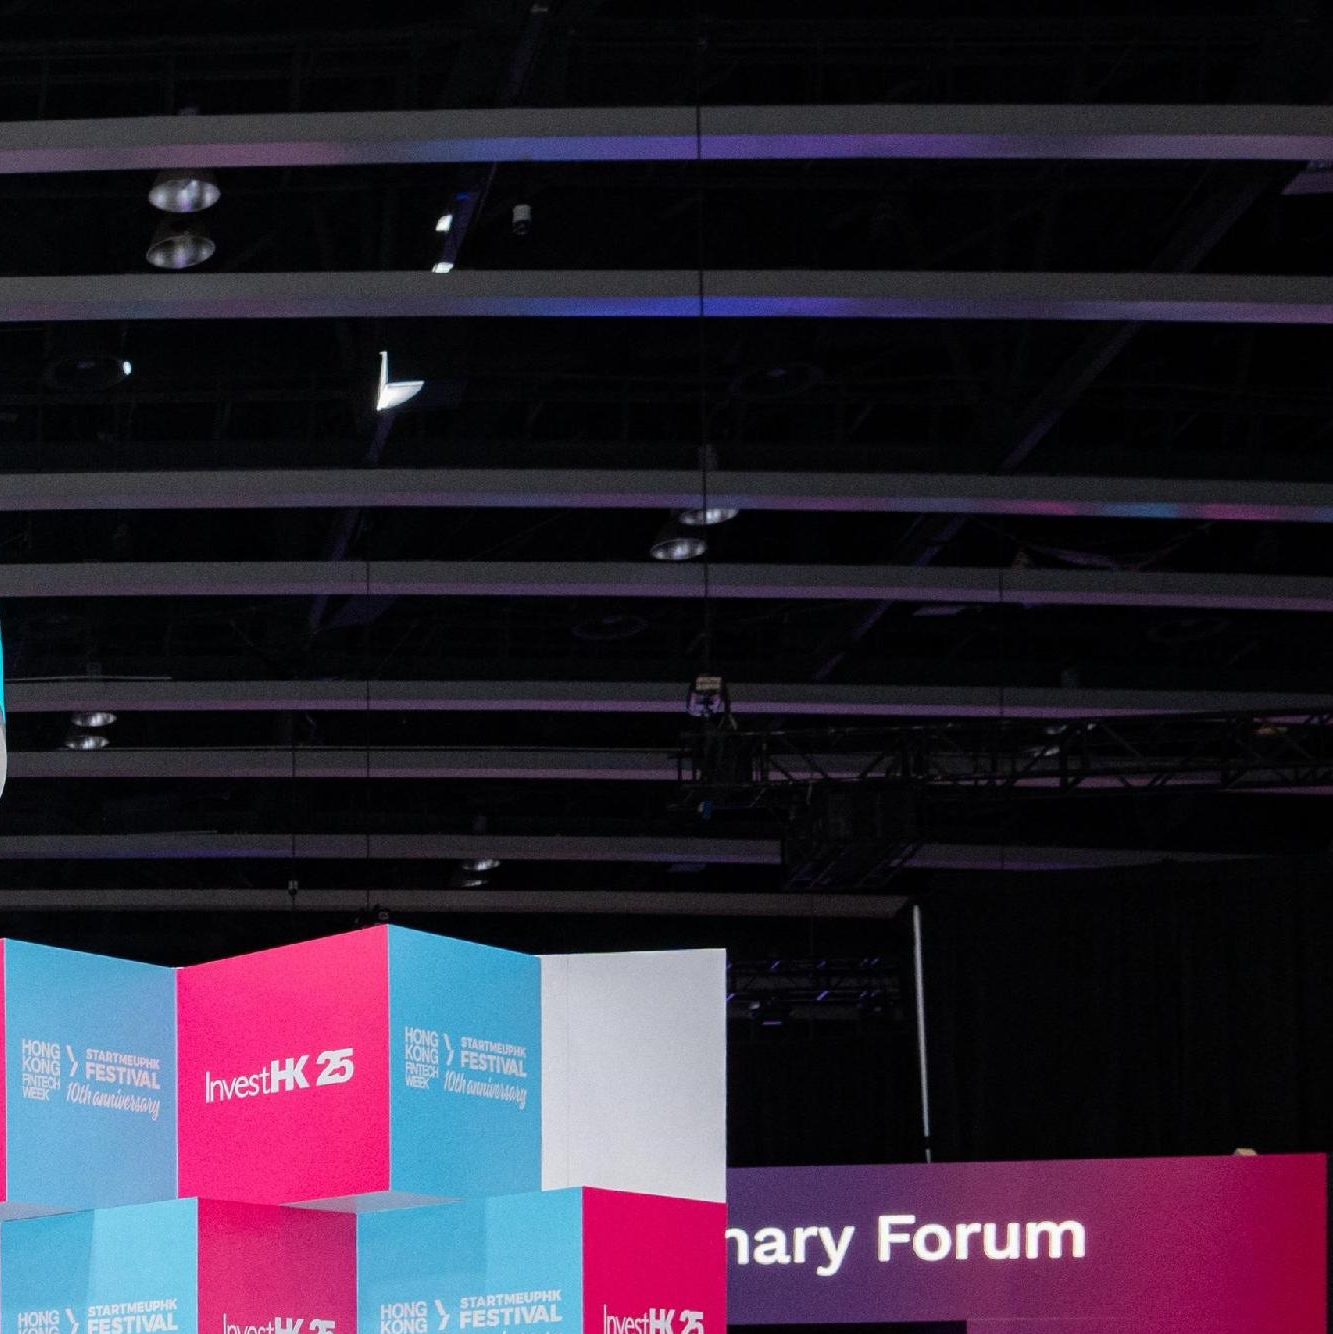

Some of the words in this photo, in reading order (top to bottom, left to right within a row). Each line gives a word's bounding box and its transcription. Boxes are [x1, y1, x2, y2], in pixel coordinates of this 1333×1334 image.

[206, 1055, 309, 1102] InvestHK
[317, 1048, 354, 1086] 25
[878, 1214, 1085, 1262] Forum
[19, 1310, 58, 1327] HONG
[381, 1302, 426, 1319] HONG
[460, 1305, 561, 1328] FESTIVAL
